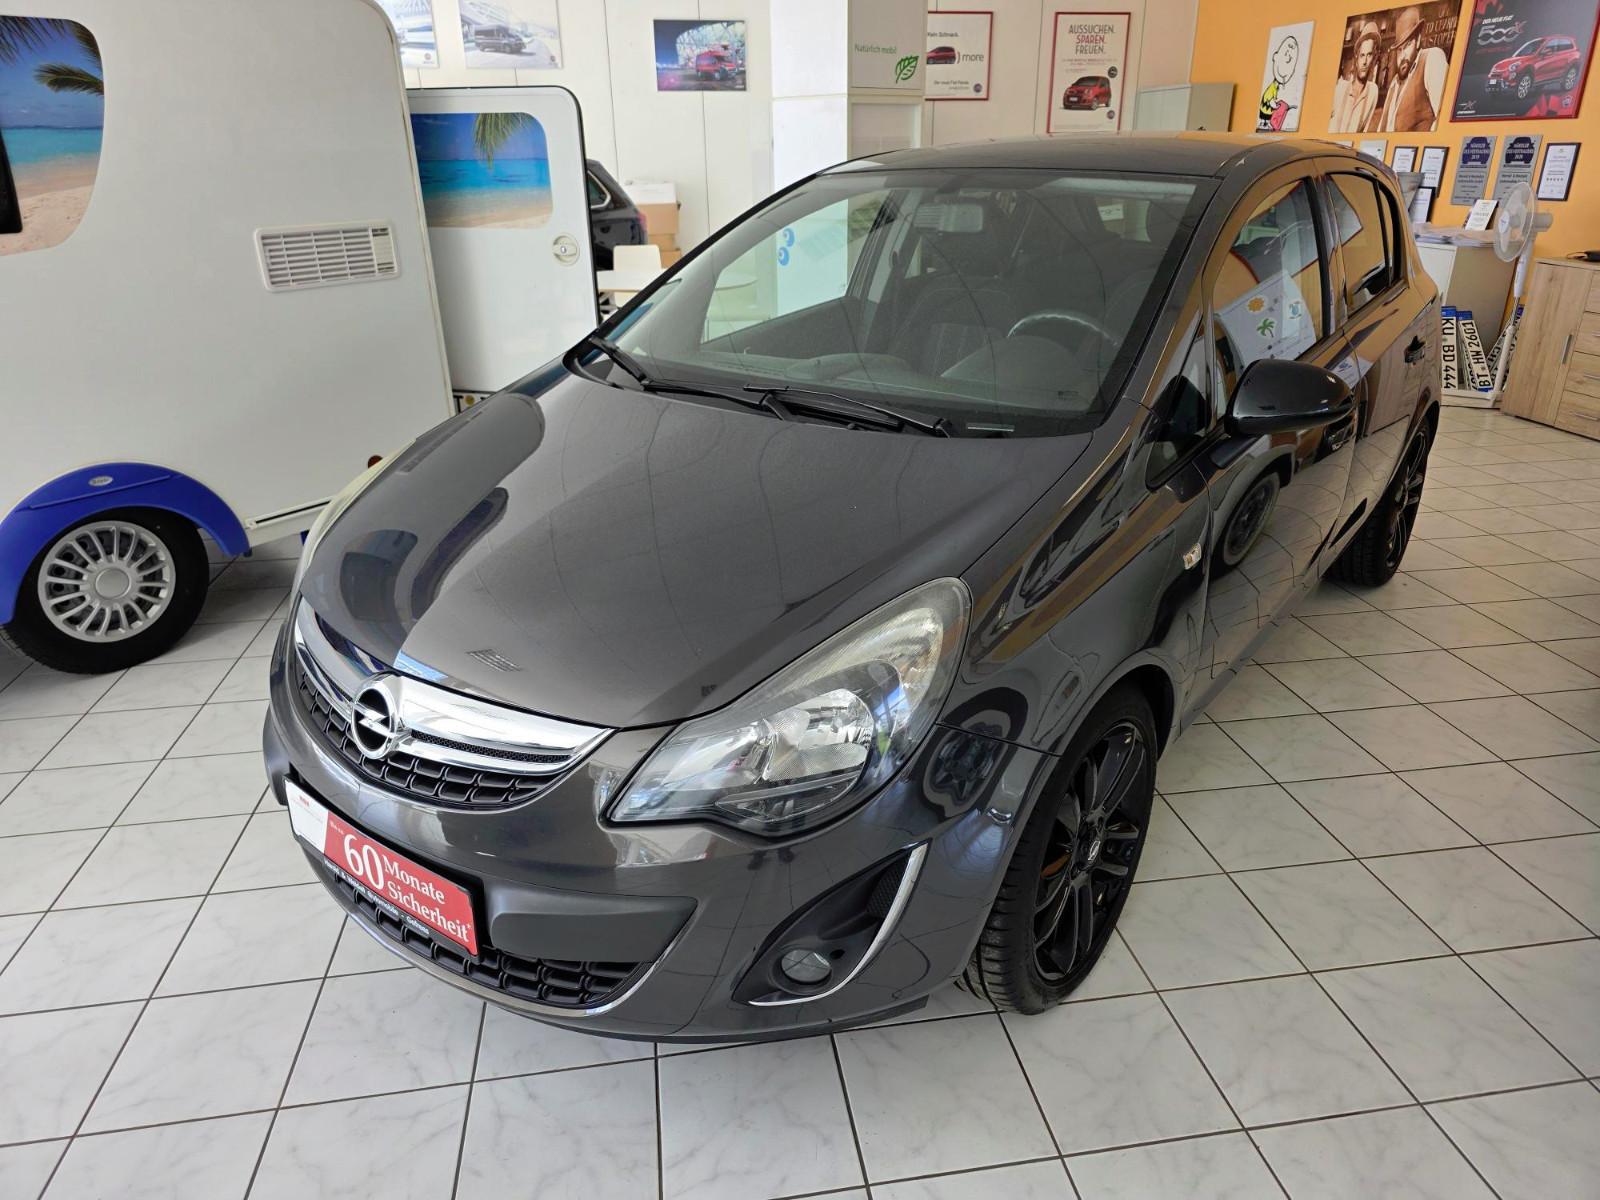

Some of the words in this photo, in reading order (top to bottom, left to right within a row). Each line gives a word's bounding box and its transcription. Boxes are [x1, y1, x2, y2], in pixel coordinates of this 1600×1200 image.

[1068, 24, 1115, 34] AUSSUCHEN.
[1076, 35, 1106, 44] SPAREN.
[854, 43, 881, 54] Natürlich
[881, 46, 898, 54] mobil
[1075, 45, 1106, 55] FREUEN.
[962, 54, 984, 62] more
[1442, 318, 1454, 336] KU
[1442, 345, 1455, 364] BD
[1470, 350, 1485, 365] HW
[1443, 367, 1456, 389] 444
[1477, 373, 1491, 387] BT
[343, 834, 385, 890] 60
[384, 855, 445, 905] Monate
